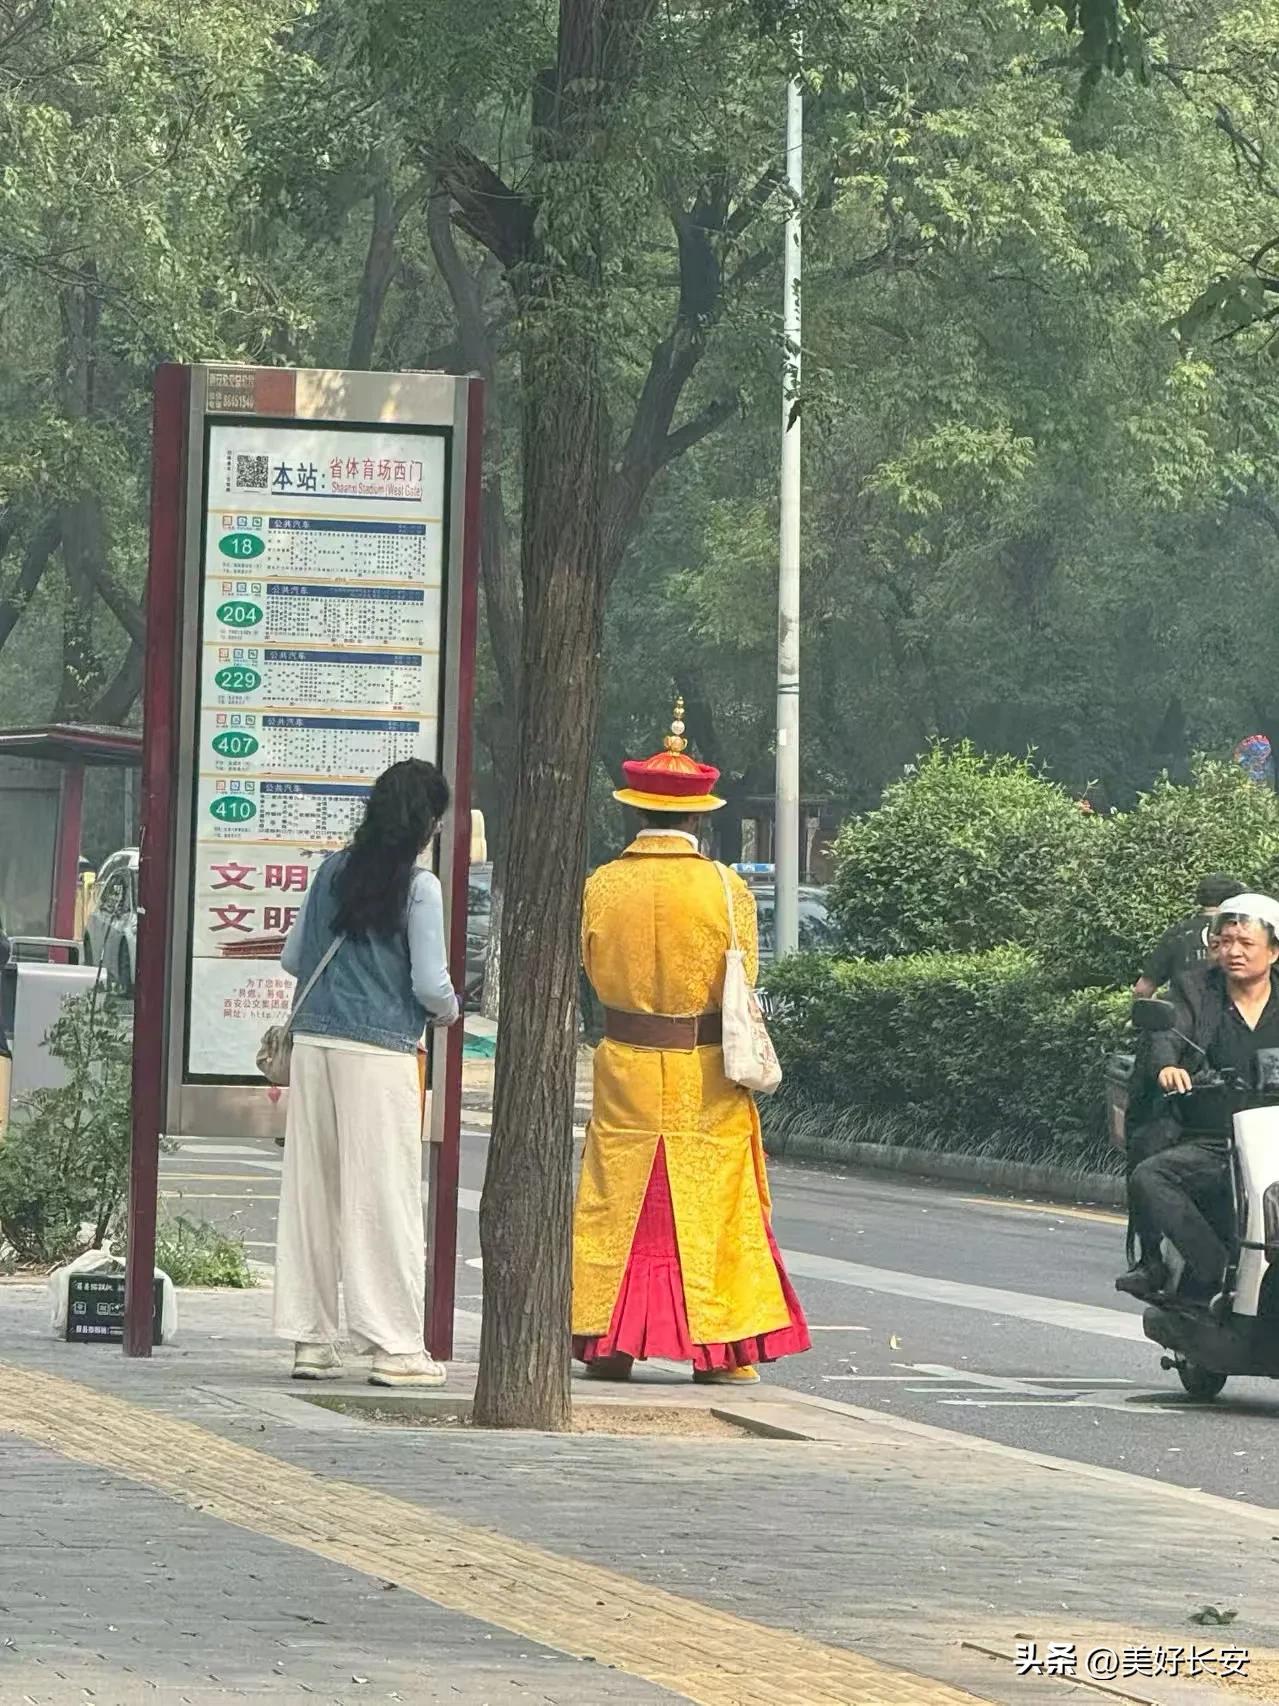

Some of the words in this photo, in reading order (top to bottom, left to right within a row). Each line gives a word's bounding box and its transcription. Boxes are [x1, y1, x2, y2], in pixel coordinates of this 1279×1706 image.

[330, 457, 423, 481] 省体育场西门
[274, 519, 310, 529] 公共汽车
[231, 538, 253, 555] 18
[272, 586, 309, 595] 公共汽车
[223, 606, 257, 622] 204
[269, 651, 307, 660] 公共汽车
[221, 671, 256, 688] 229
[267, 718, 304, 727] 公共汽车
[218, 737, 253, 753] 407
[265, 784, 302, 793] 公共汽车
[215, 802, 251, 818] 410
[210, 862, 308, 892] 文明
